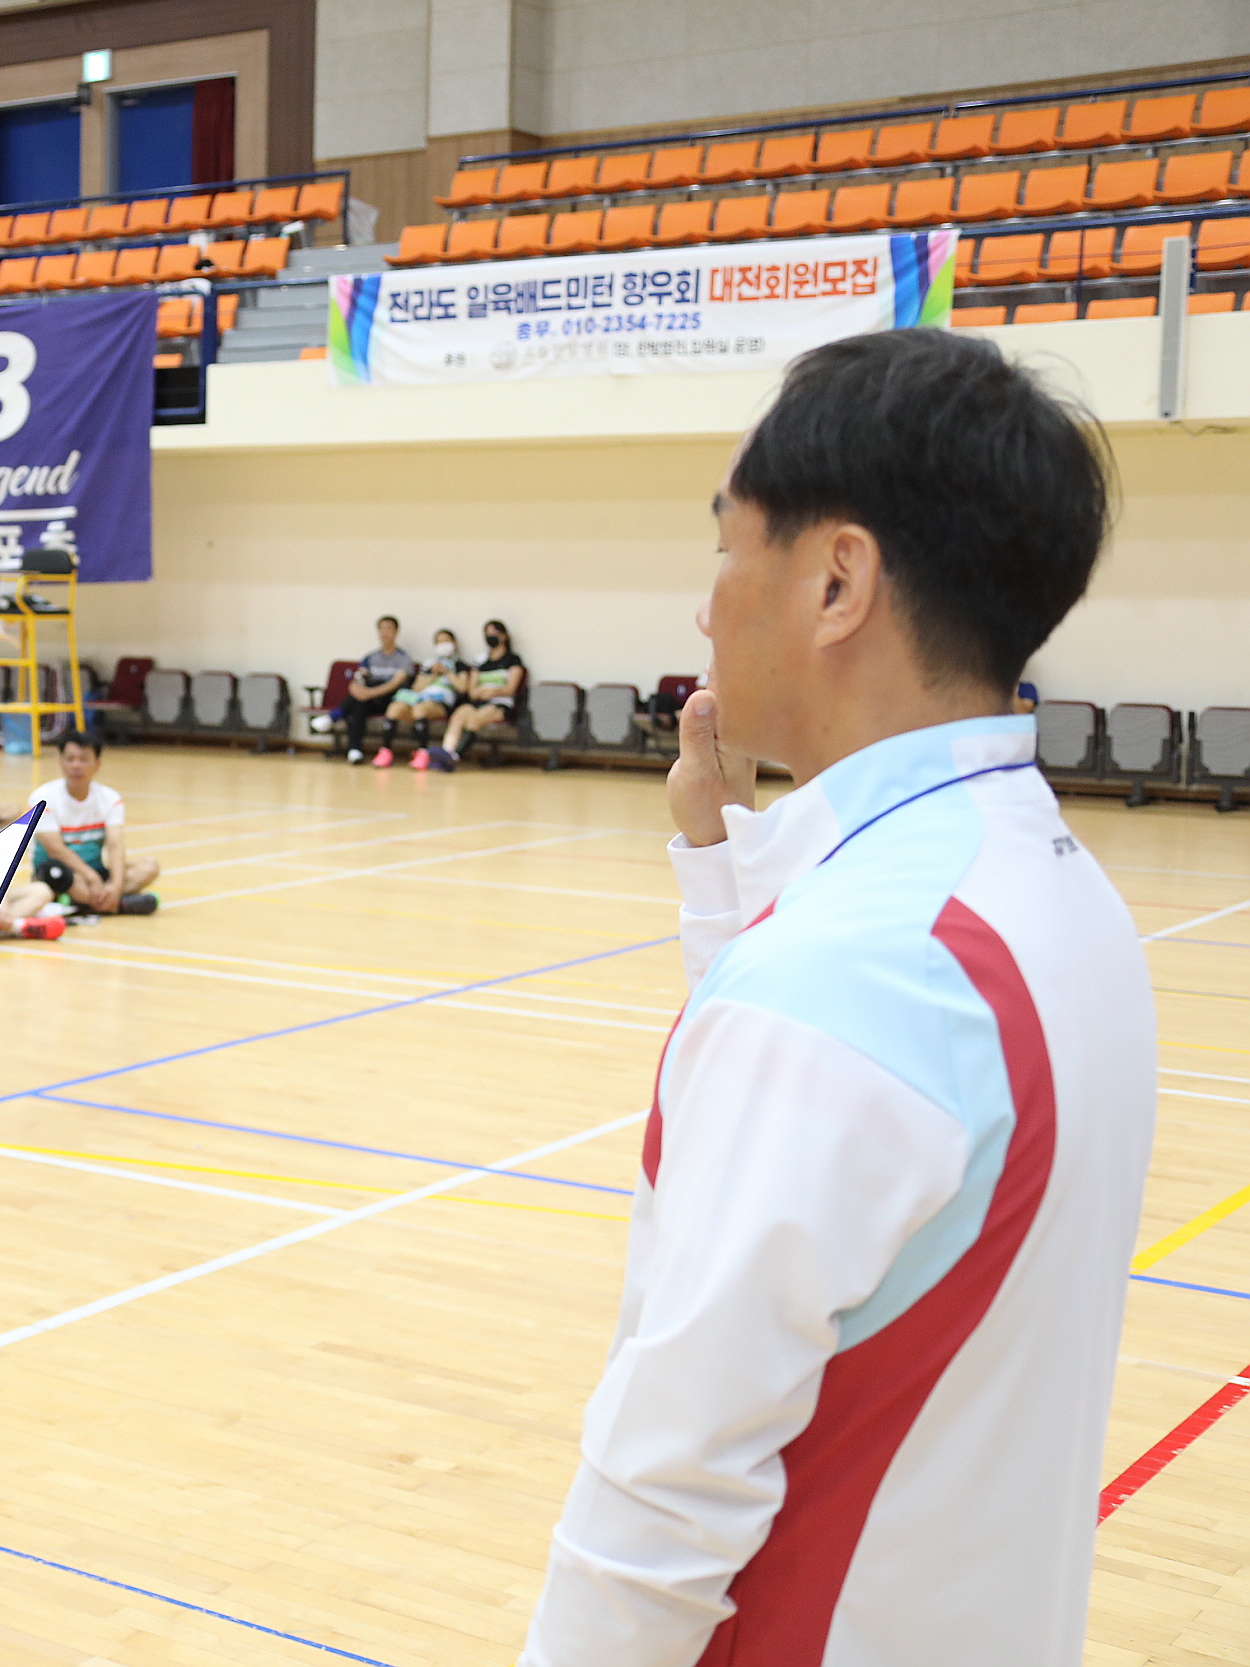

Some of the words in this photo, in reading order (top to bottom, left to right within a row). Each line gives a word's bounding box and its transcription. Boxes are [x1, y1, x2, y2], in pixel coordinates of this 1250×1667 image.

[389, 289, 457, 323] 전라도
[622, 268, 701, 306] 향우회
[709, 257, 878, 302] 대전회원모집
[562, 312, 702, 335] 010-2354-7225
